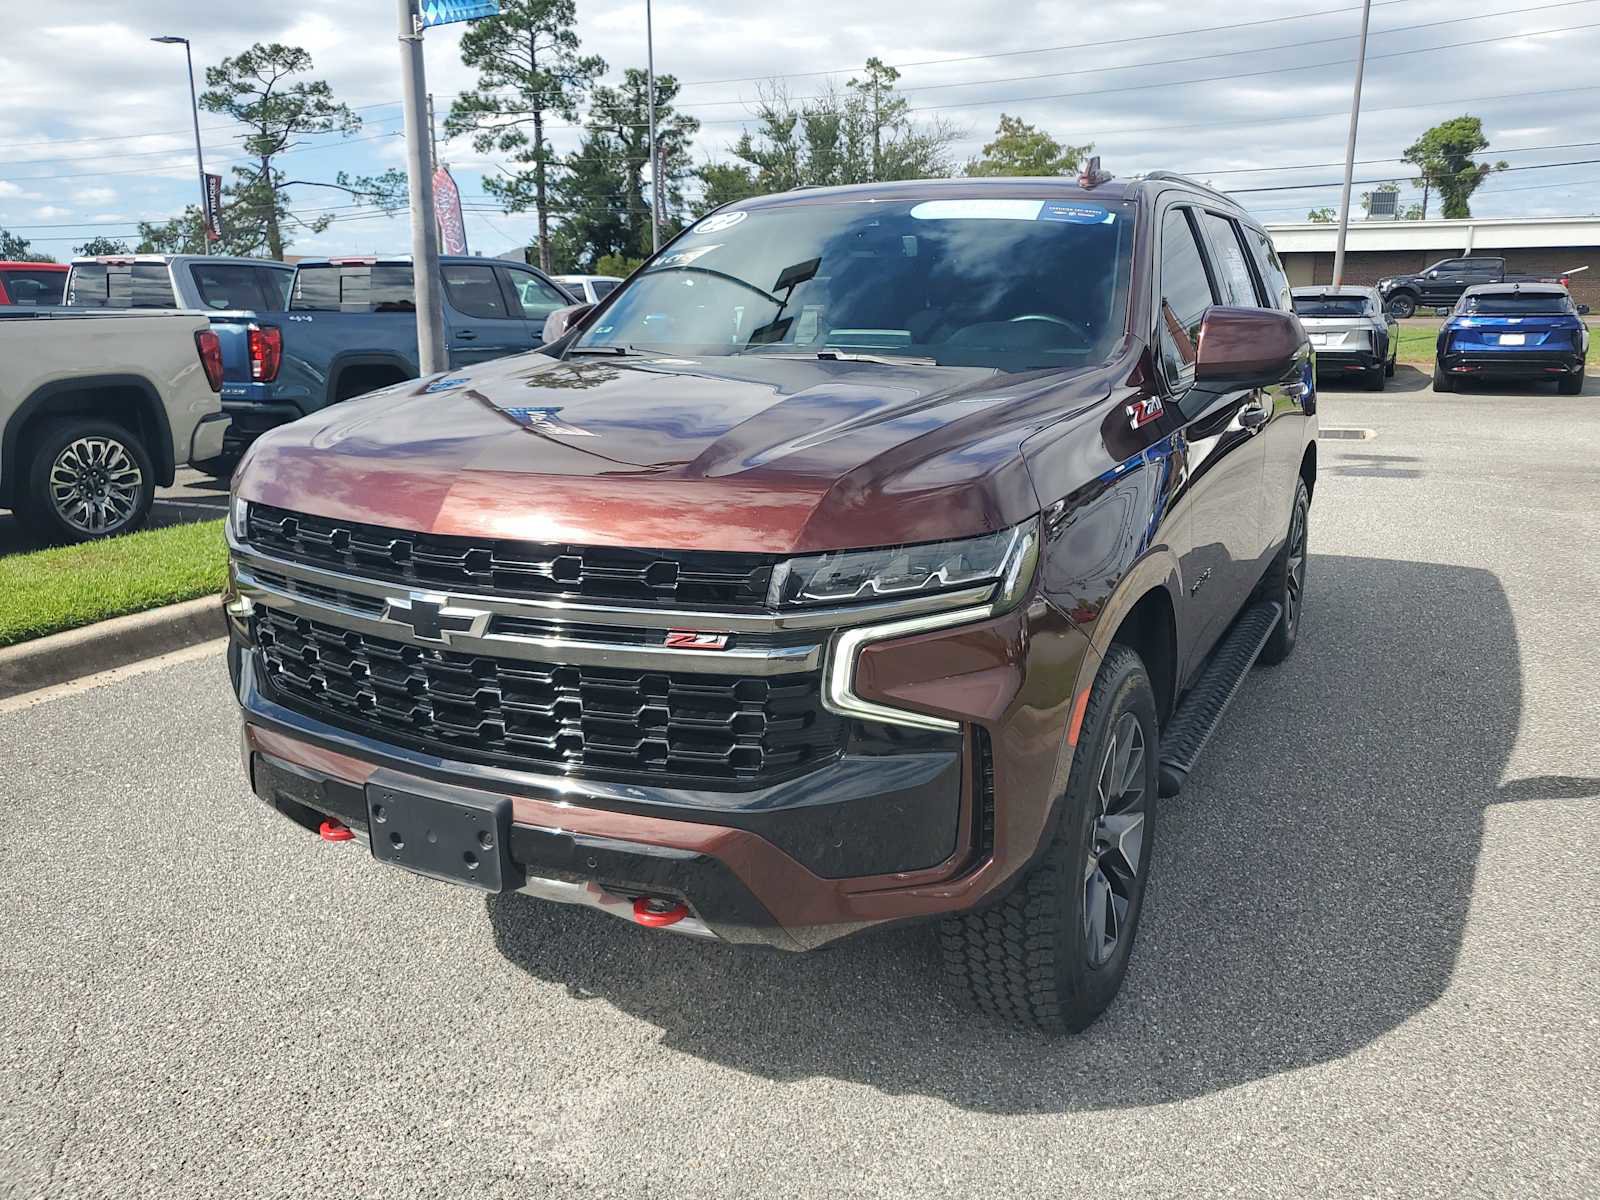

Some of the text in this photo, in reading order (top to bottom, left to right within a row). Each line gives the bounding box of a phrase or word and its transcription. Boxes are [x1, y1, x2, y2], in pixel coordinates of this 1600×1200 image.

[209, 177, 222, 236] NEW TRUCKS
[1125, 395, 1164, 430] Z71
[664, 632, 729, 650] Z71
